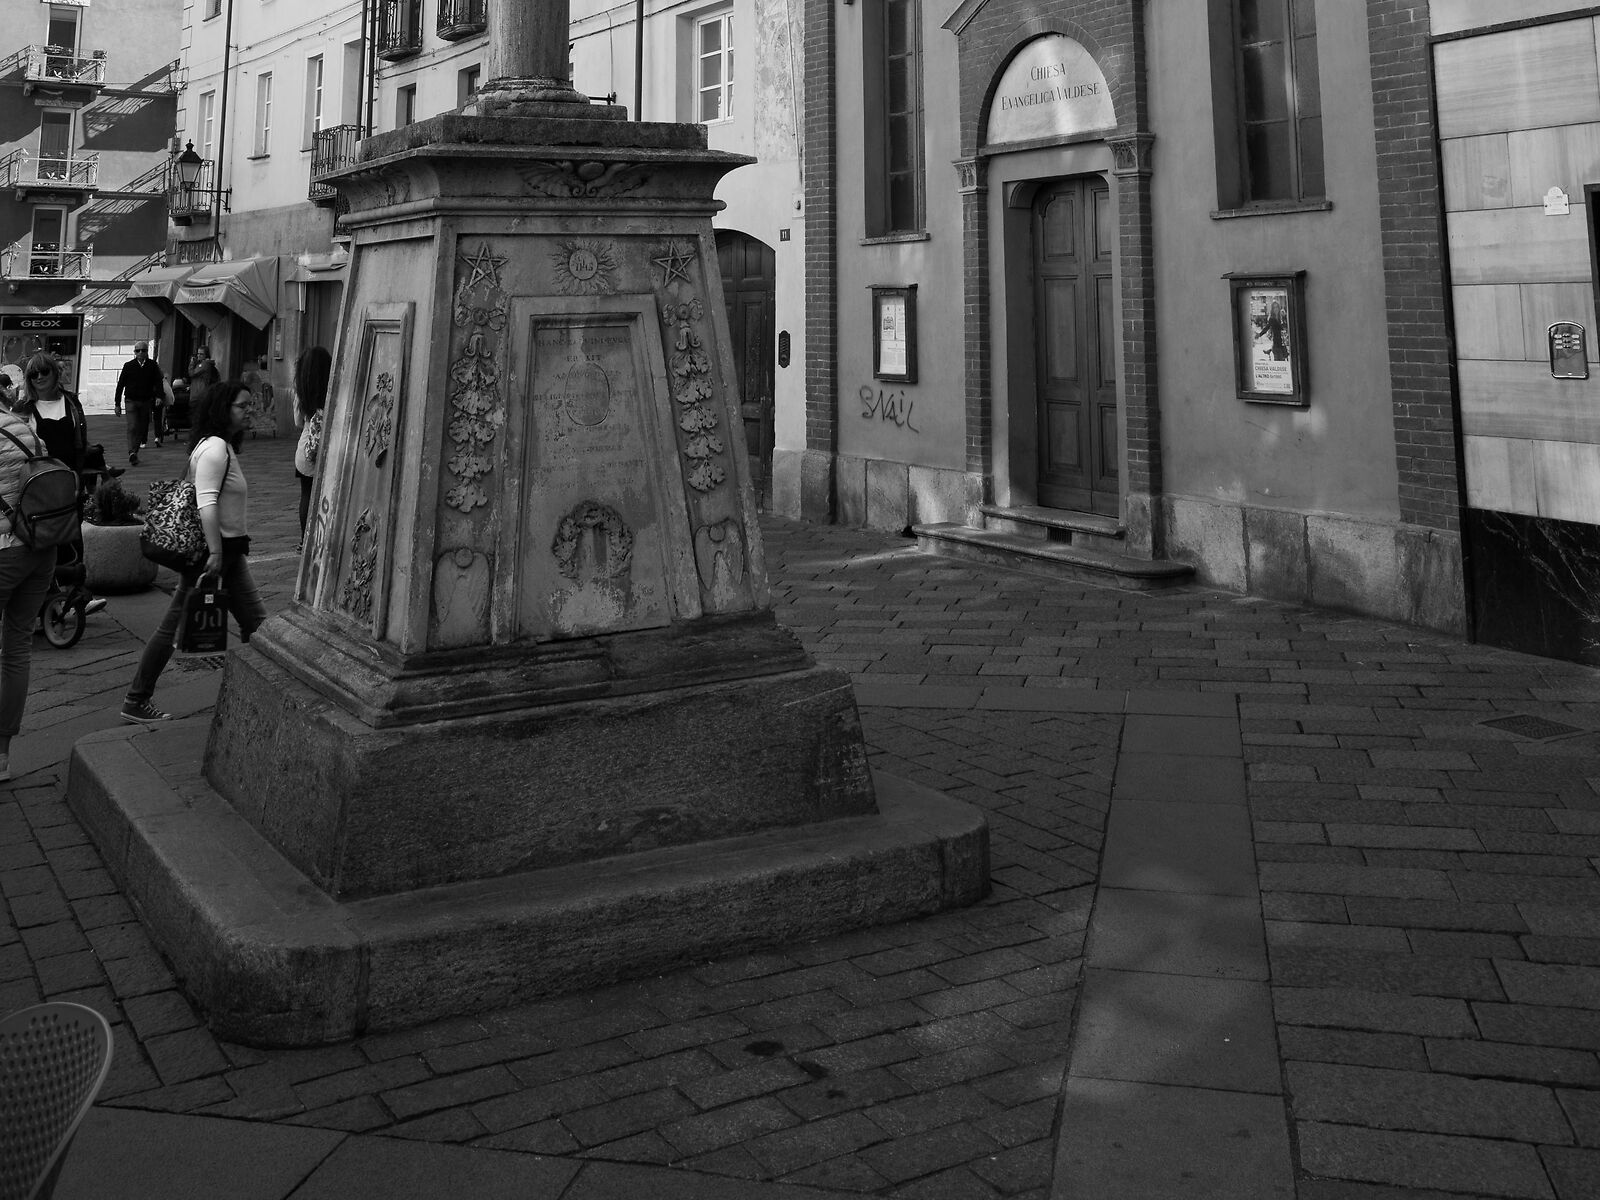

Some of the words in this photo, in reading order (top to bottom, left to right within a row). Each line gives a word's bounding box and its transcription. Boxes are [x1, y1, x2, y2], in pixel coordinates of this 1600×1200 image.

[1030, 62, 1066, 81] CHIESA
[1001, 90, 1055, 111] EVANGELICA
[1056, 82, 1101, 103] VALDESE
[20, 319, 61, 328] GEOX
